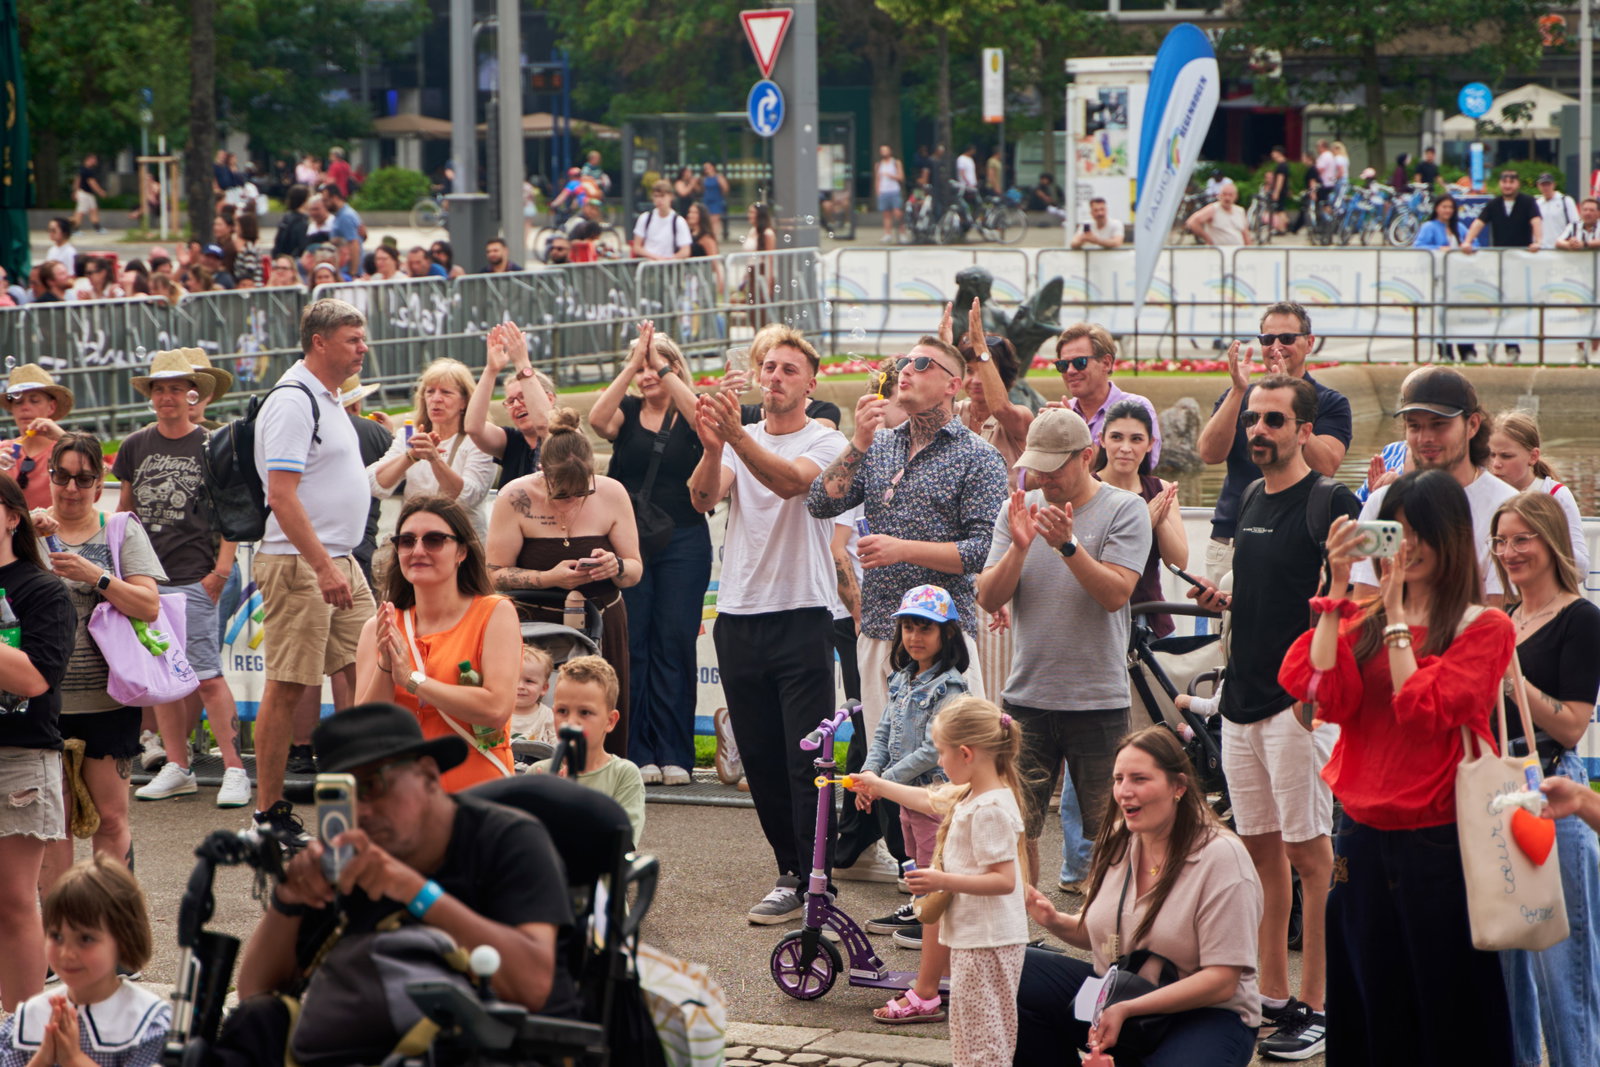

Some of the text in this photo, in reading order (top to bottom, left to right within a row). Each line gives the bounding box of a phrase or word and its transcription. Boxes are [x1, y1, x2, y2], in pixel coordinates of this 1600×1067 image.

[132, 453, 202, 486] Authentic
[235, 654, 264, 672] REG
[696, 666, 720, 685] OG
